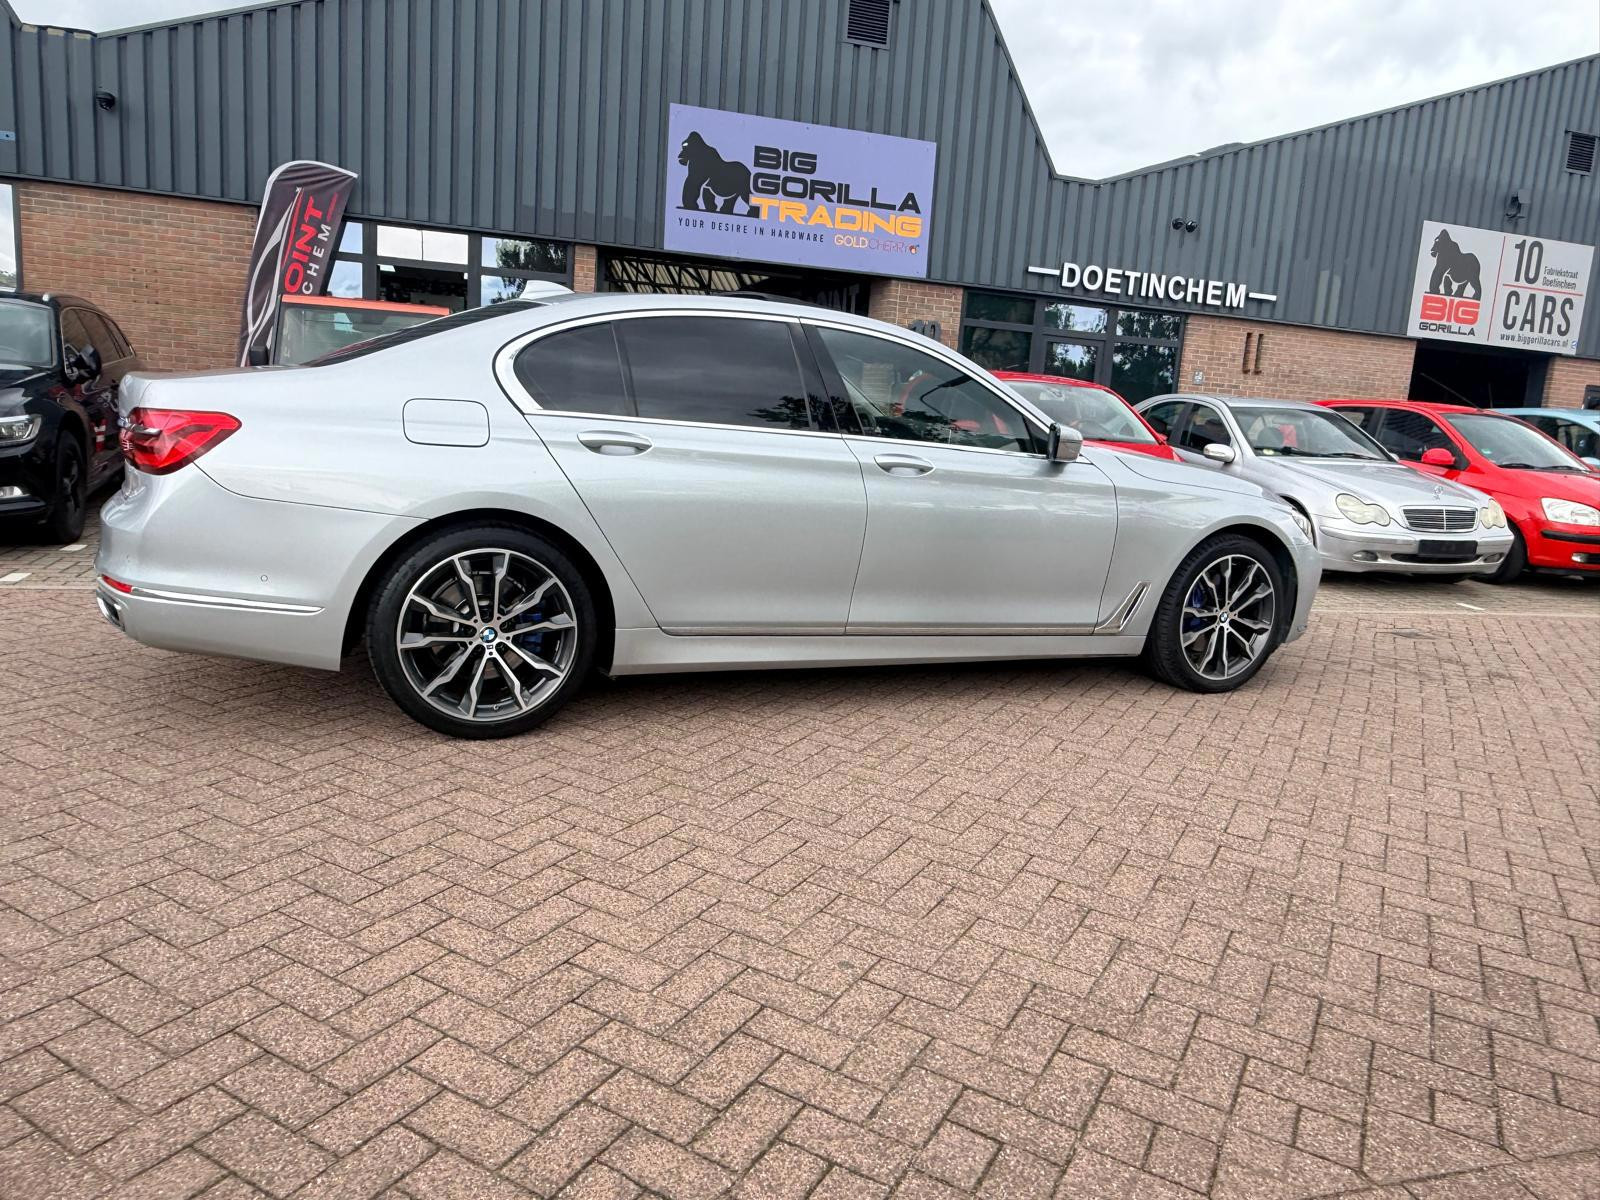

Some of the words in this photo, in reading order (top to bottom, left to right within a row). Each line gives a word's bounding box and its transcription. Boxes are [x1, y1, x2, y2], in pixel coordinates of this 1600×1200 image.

[753, 145, 817, 175] BIG
[752, 172, 921, 214] GORILLA
[678, 217, 705, 229] YOUR
[711, 221, 748, 234] DESIRE
[754, 226, 765, 236] IN
[771, 229, 825, 243] HARDWARE
[749, 196, 923, 238] TRADING
[1514, 239, 1544, 285] 10
[1061, 262, 1247, 309] DOETINCHEM
[1541, 276, 1577, 291] Doetinchem
[1419, 294, 1481, 326] BIG
[1502, 290, 1574, 337] CARS
[1418, 321, 1476, 337] GORILLA
[1500, 333, 1569, 348] www.biggorillacars.nl
